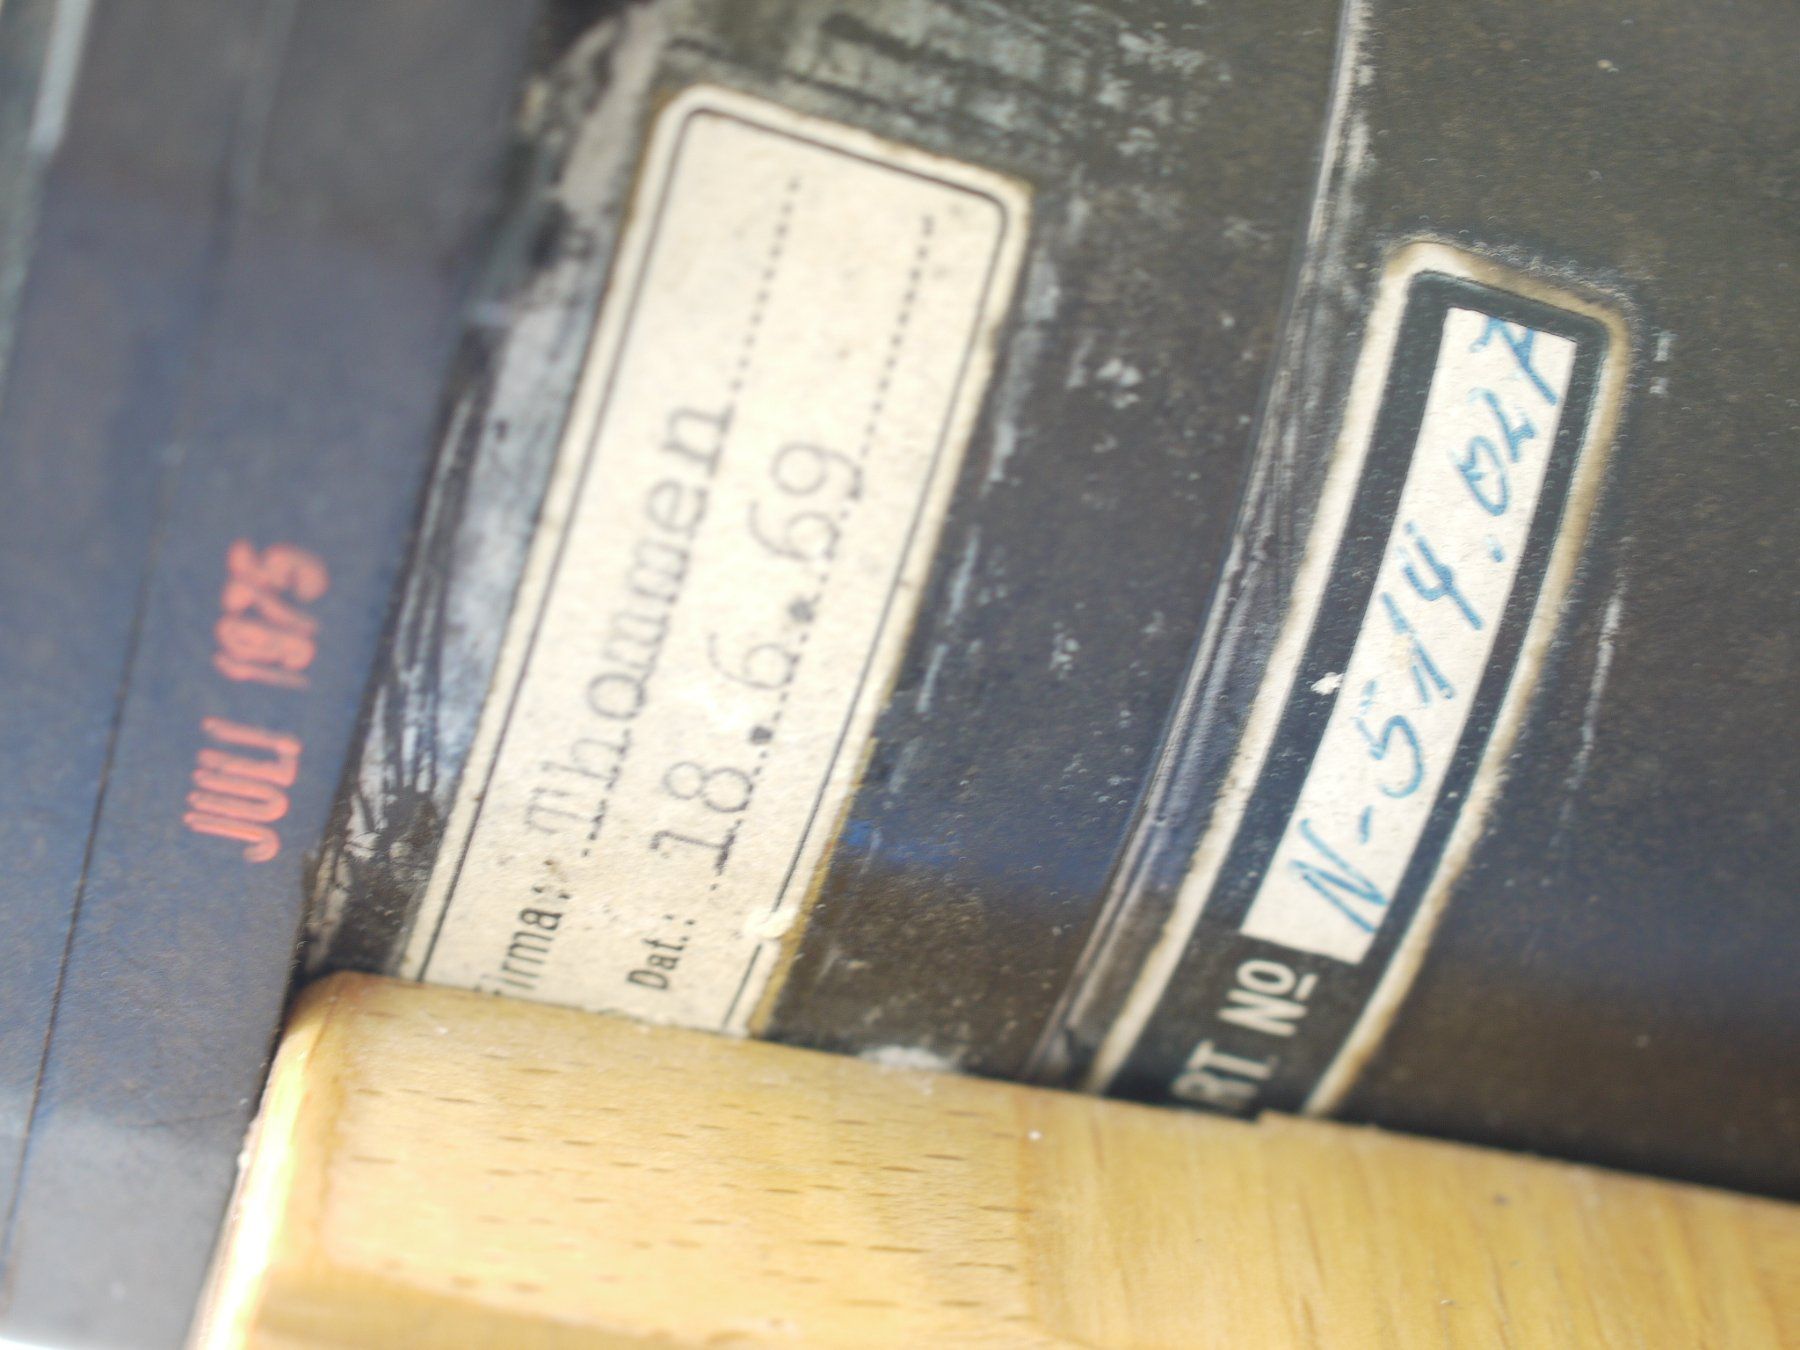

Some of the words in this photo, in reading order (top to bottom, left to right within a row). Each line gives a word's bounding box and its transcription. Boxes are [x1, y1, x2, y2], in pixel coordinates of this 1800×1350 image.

[213, 539, 330, 688] 1975
[523, 403, 733, 836] Thommen
[183, 716, 302, 863] JULI
[624, 914, 697, 991] Dat.:
